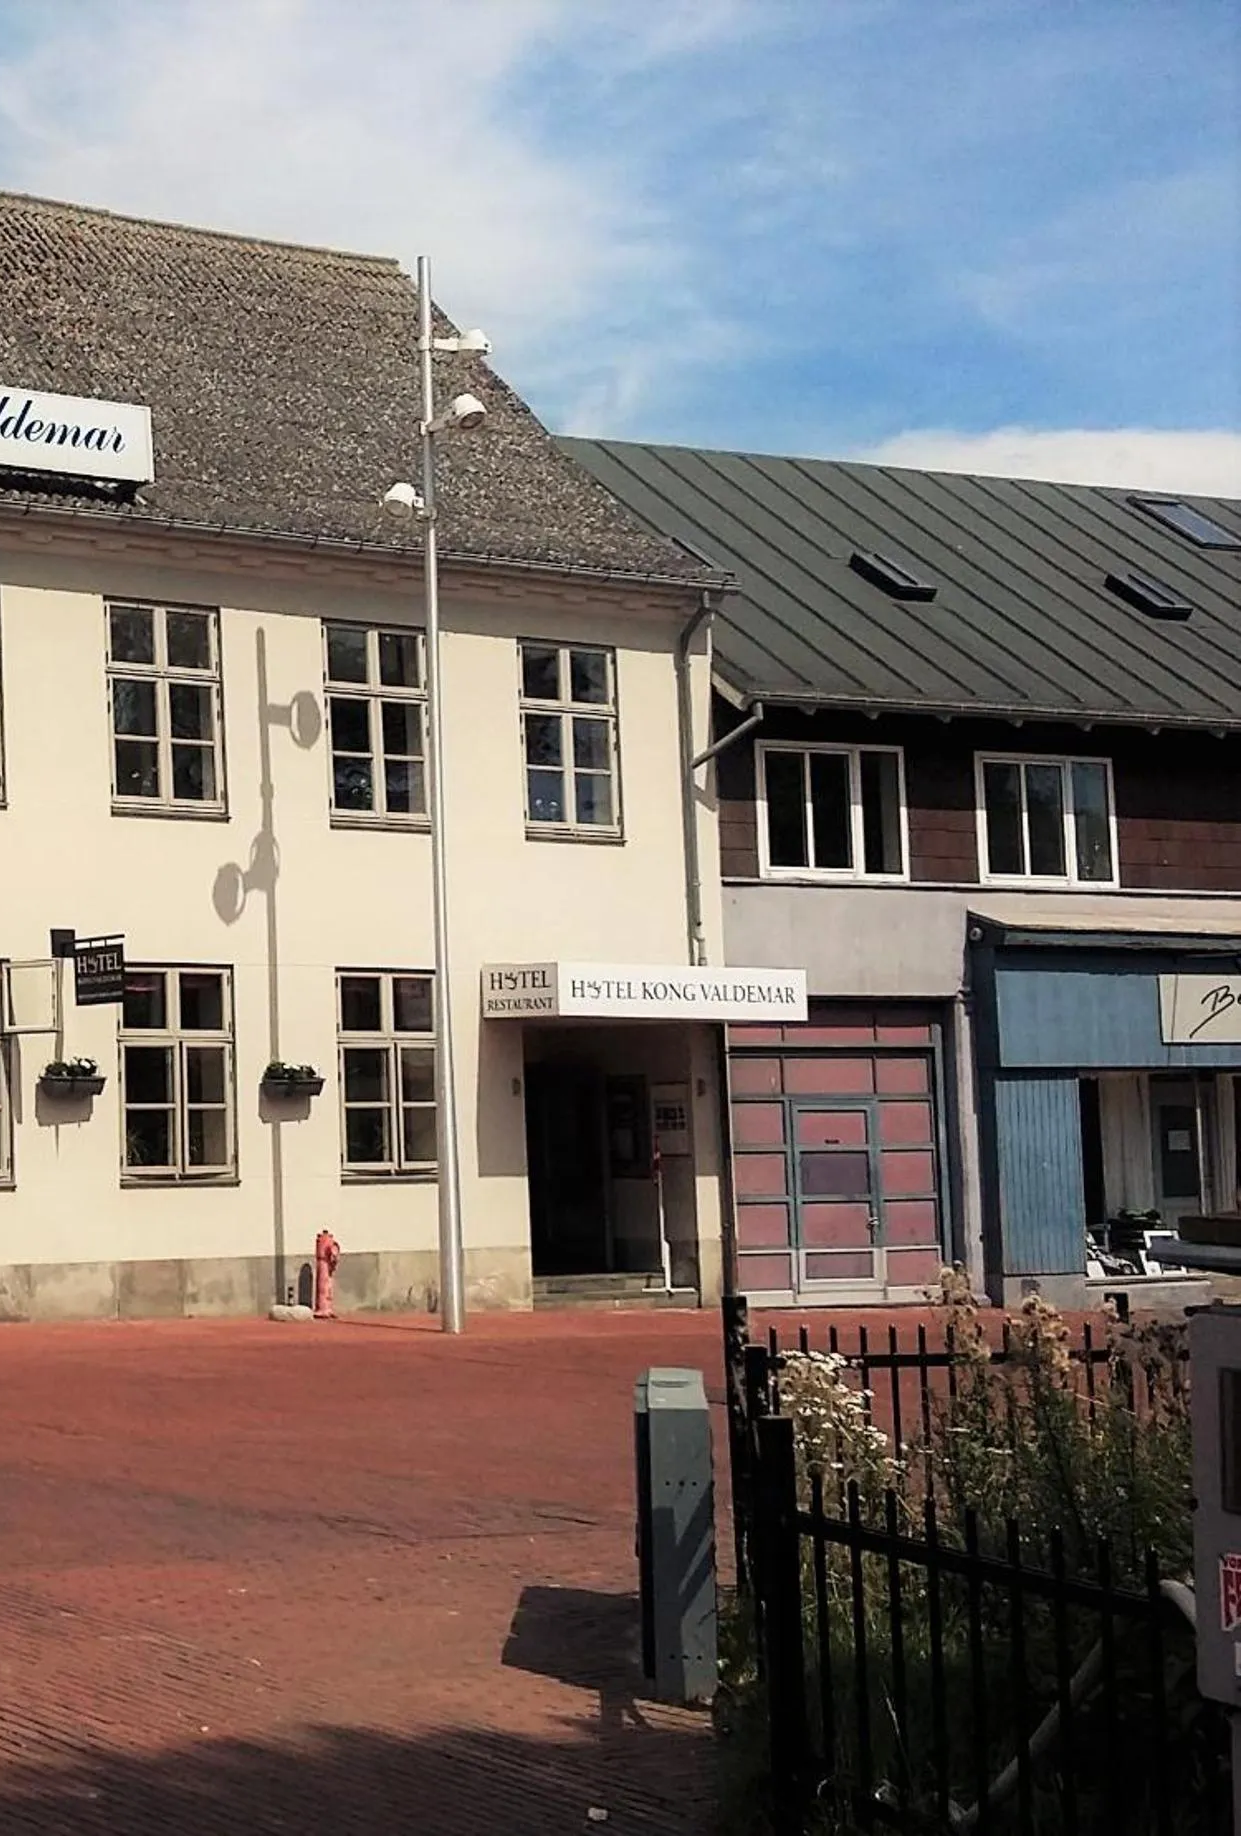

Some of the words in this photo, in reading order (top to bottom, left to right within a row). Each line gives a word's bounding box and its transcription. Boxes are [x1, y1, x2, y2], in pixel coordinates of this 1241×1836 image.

[641, 981, 696, 1002] KONG
[701, 983, 797, 1005] VALDEMAR
[487, 996, 554, 1012] RESTAURANT
